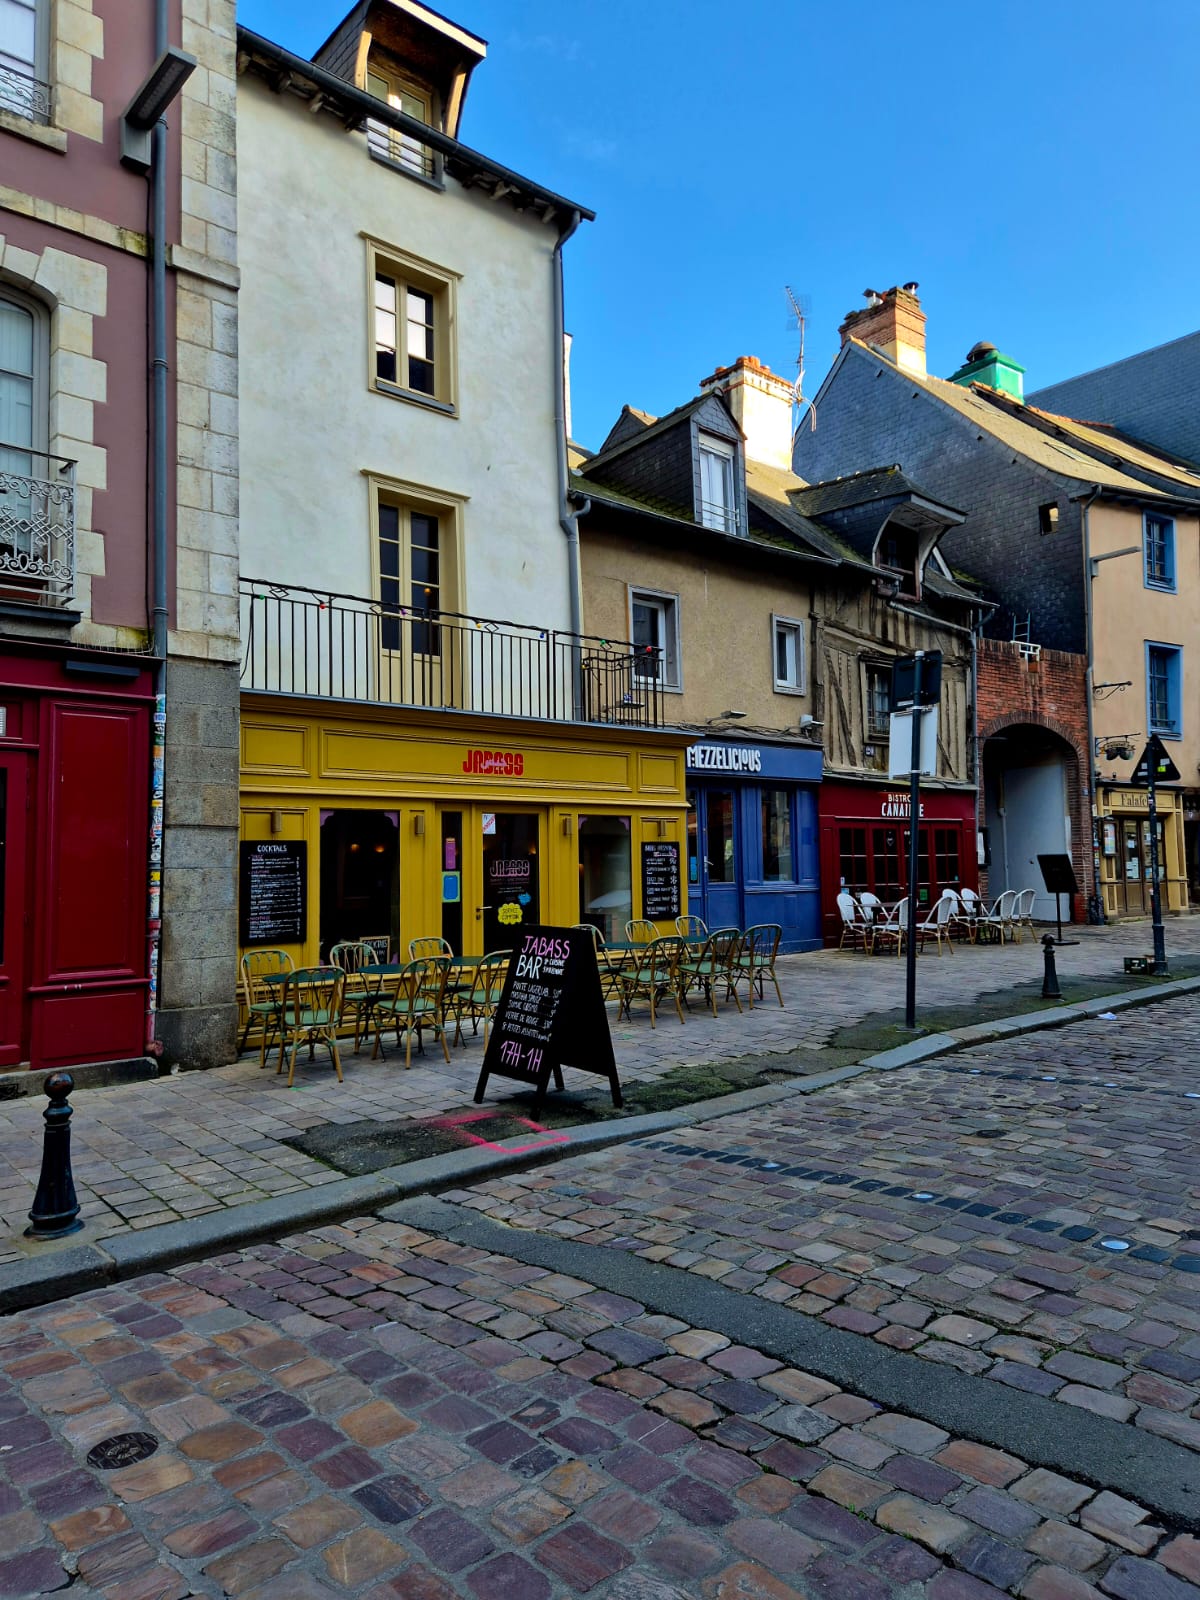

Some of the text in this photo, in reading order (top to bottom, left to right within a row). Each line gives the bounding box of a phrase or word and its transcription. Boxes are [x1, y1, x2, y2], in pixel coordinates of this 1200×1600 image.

[462, 750, 524, 776] JABASS
[686, 745, 762, 772] MEZZELICIOUS
[521, 935, 570, 959] JABASS
[515, 954, 543, 980] BAR
